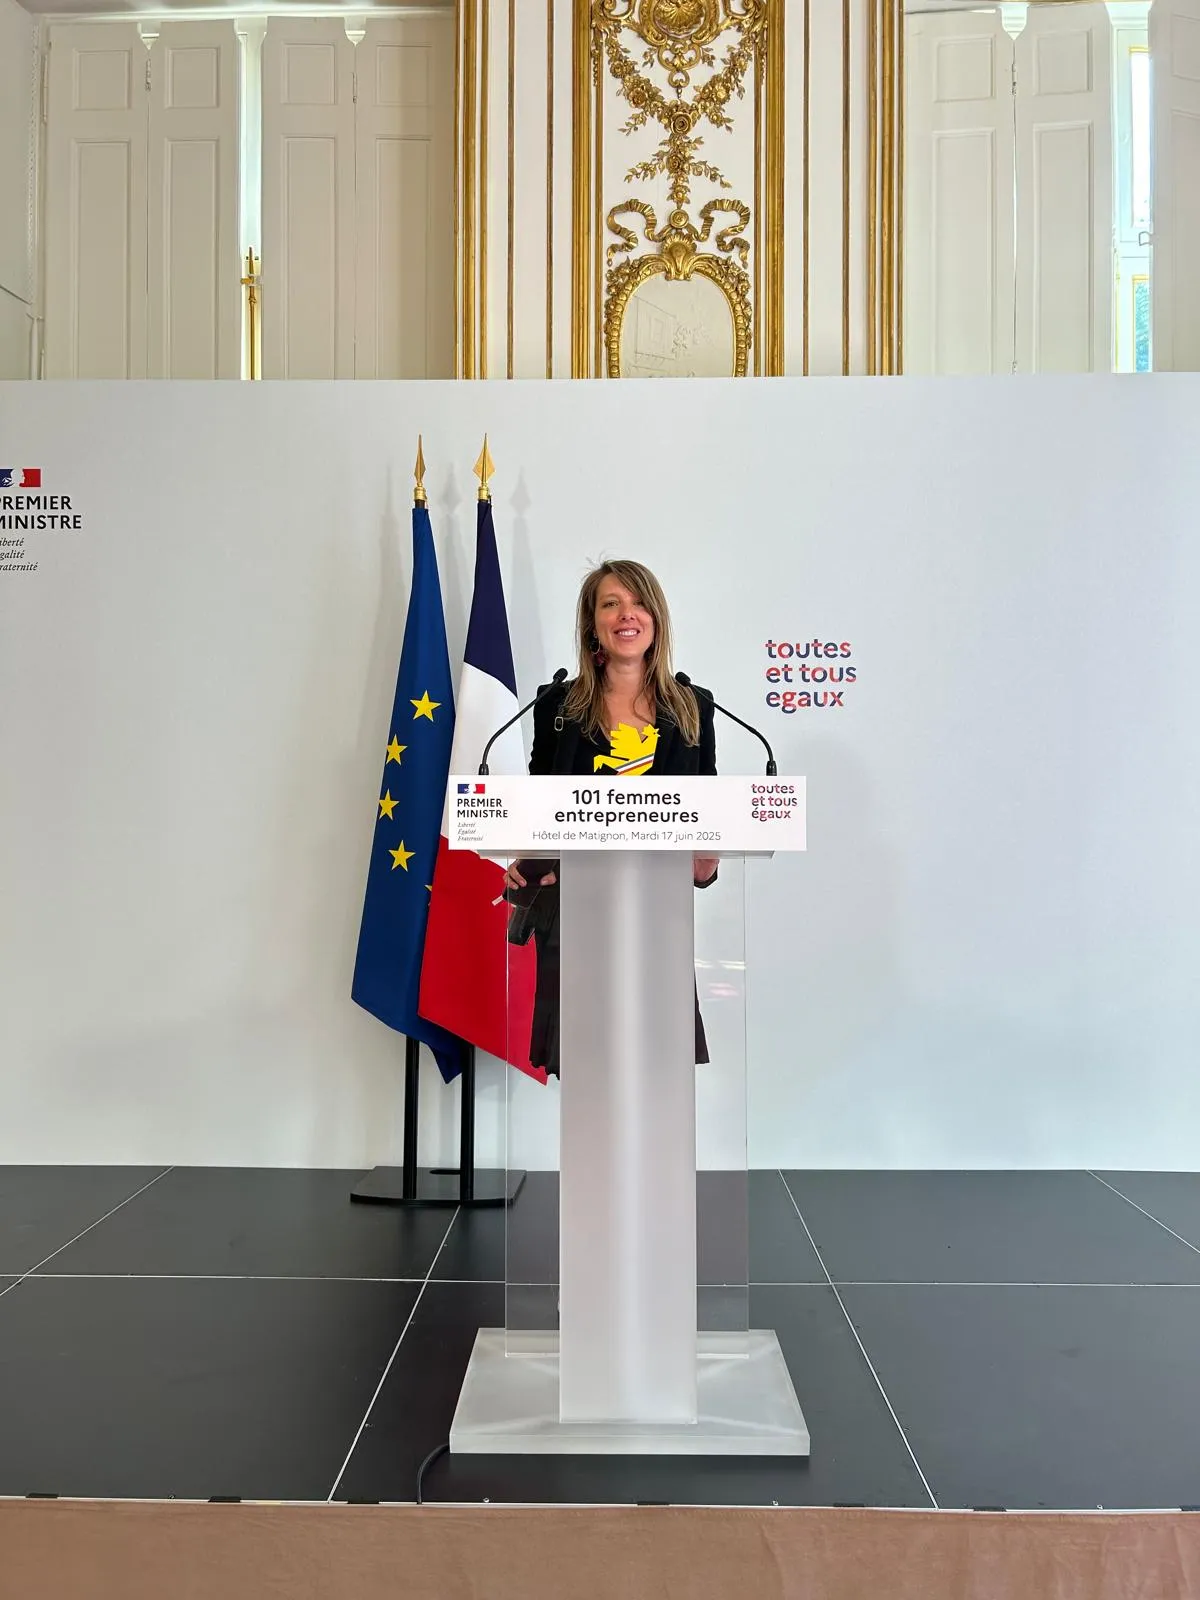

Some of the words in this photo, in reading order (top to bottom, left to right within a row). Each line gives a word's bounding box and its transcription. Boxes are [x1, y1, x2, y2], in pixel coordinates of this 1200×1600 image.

[0, 495, 73, 510] REMIER
[0, 537, 25, 547] iberté
[0, 549, 25, 561] galité
[0, 562, 39, 571] raternité
[765, 638, 852, 659] toutes
[766, 664, 793, 683] et
[799, 664, 857, 683] tous
[765, 691, 844, 714] egaux
[751, 783, 795, 794] toutes
[457, 798, 503, 808] PREMIER
[571, 789, 601, 805] 101
[606, 788, 682, 805] femmes
[751, 796, 766, 807] et
[767, 796, 798, 807] tous
[457, 809, 509, 819] MINISTRE
[554, 809, 700, 827] entrepreneures
[751, 806, 792, 822] égaux
[532, 830, 561, 841] Hôtel
[562, 830, 577, 841] de
[579, 830, 629, 843] Matignon,
[631, 830, 660, 841] Mardi
[661, 831, 673, 841] 17
[673, 830, 694, 843] juin
[696, 831, 722, 841] 2025
